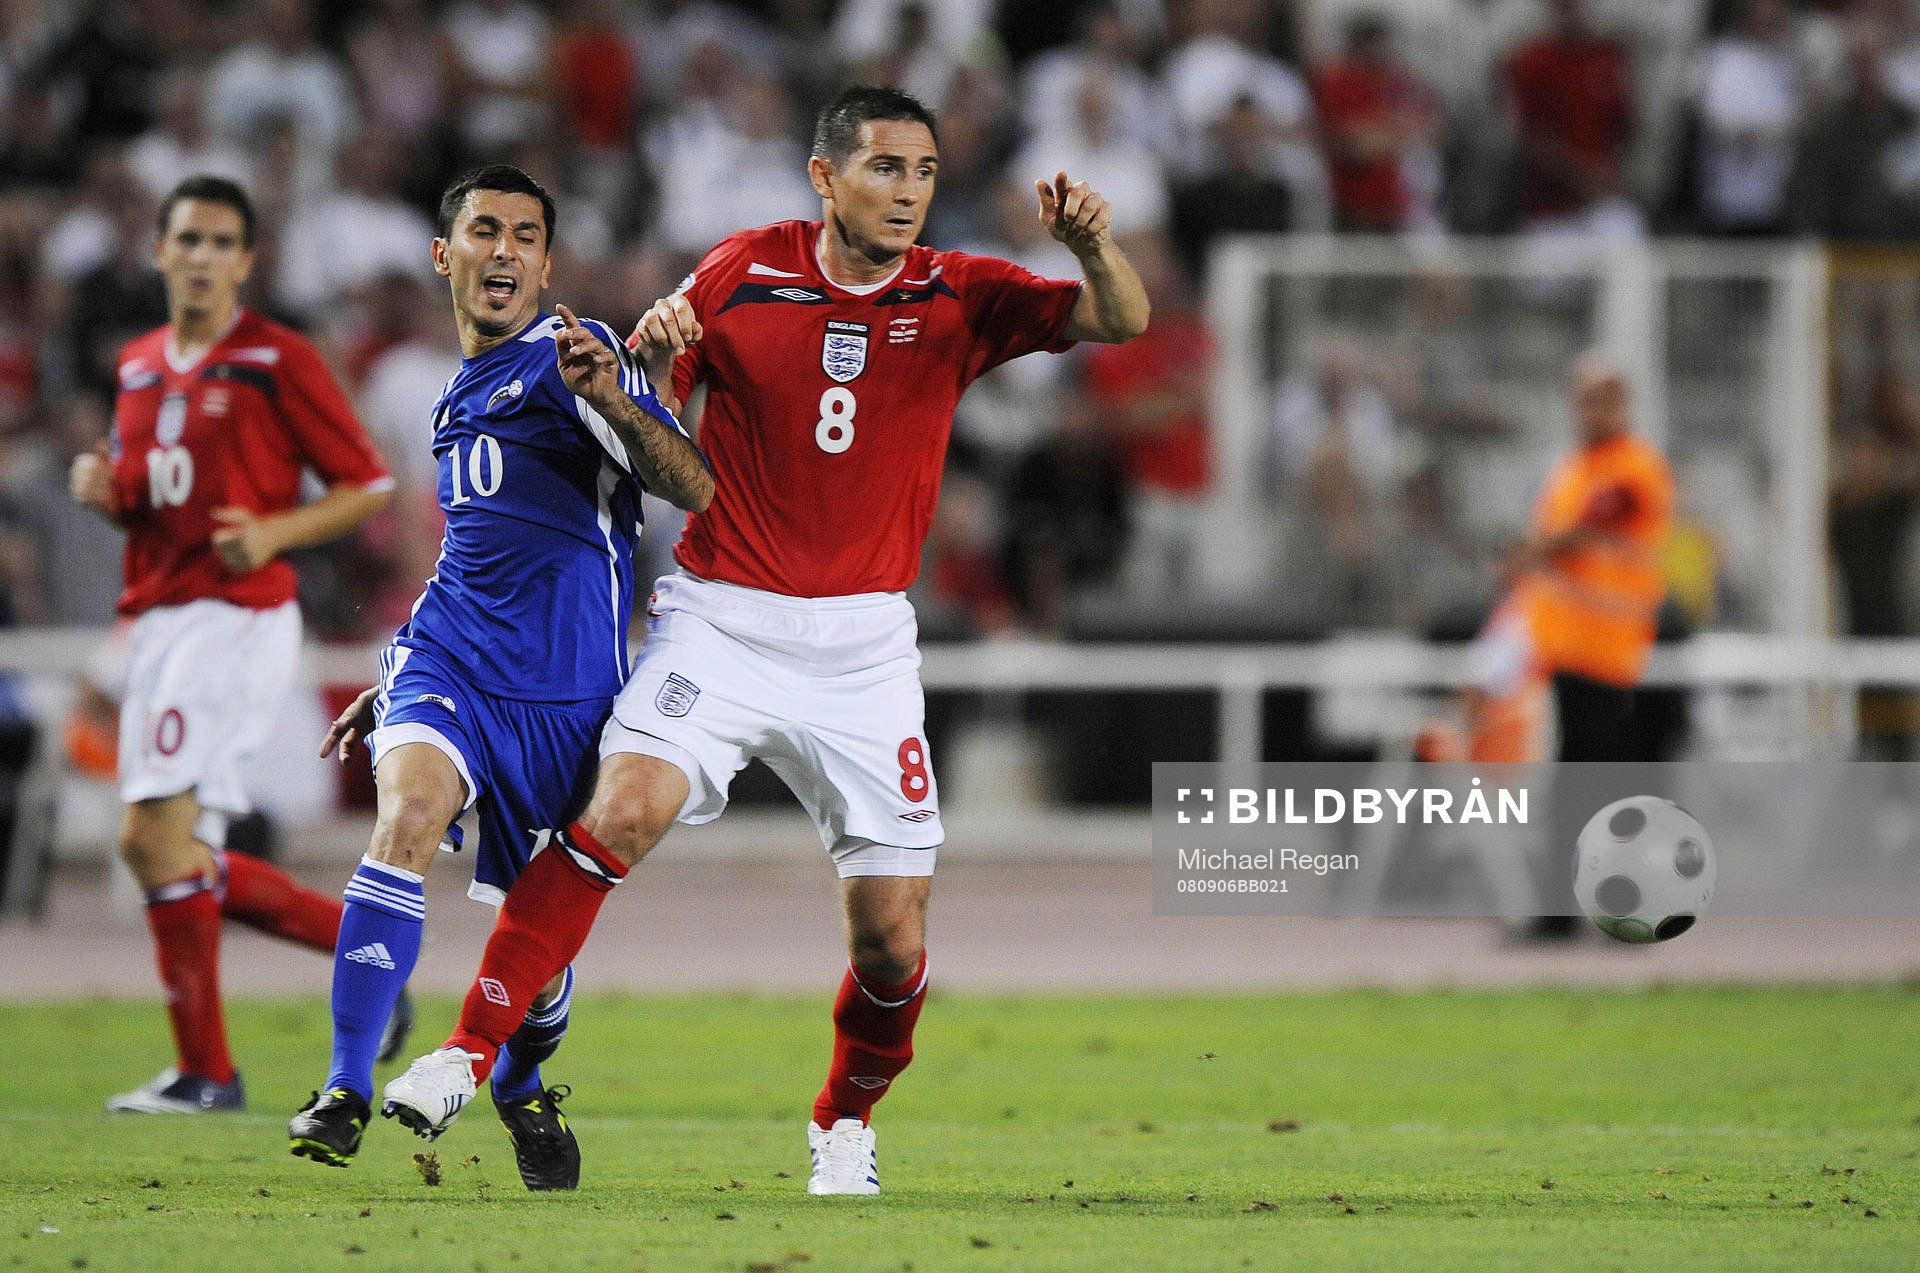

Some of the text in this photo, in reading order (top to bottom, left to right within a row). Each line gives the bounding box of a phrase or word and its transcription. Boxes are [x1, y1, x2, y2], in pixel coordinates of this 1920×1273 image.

[814, 386, 857, 454] 8
[146, 446, 194, 509] 10
[448, 434, 504, 507] 10
[897, 736, 929, 803] 8
[344, 952, 396, 970] adidas
